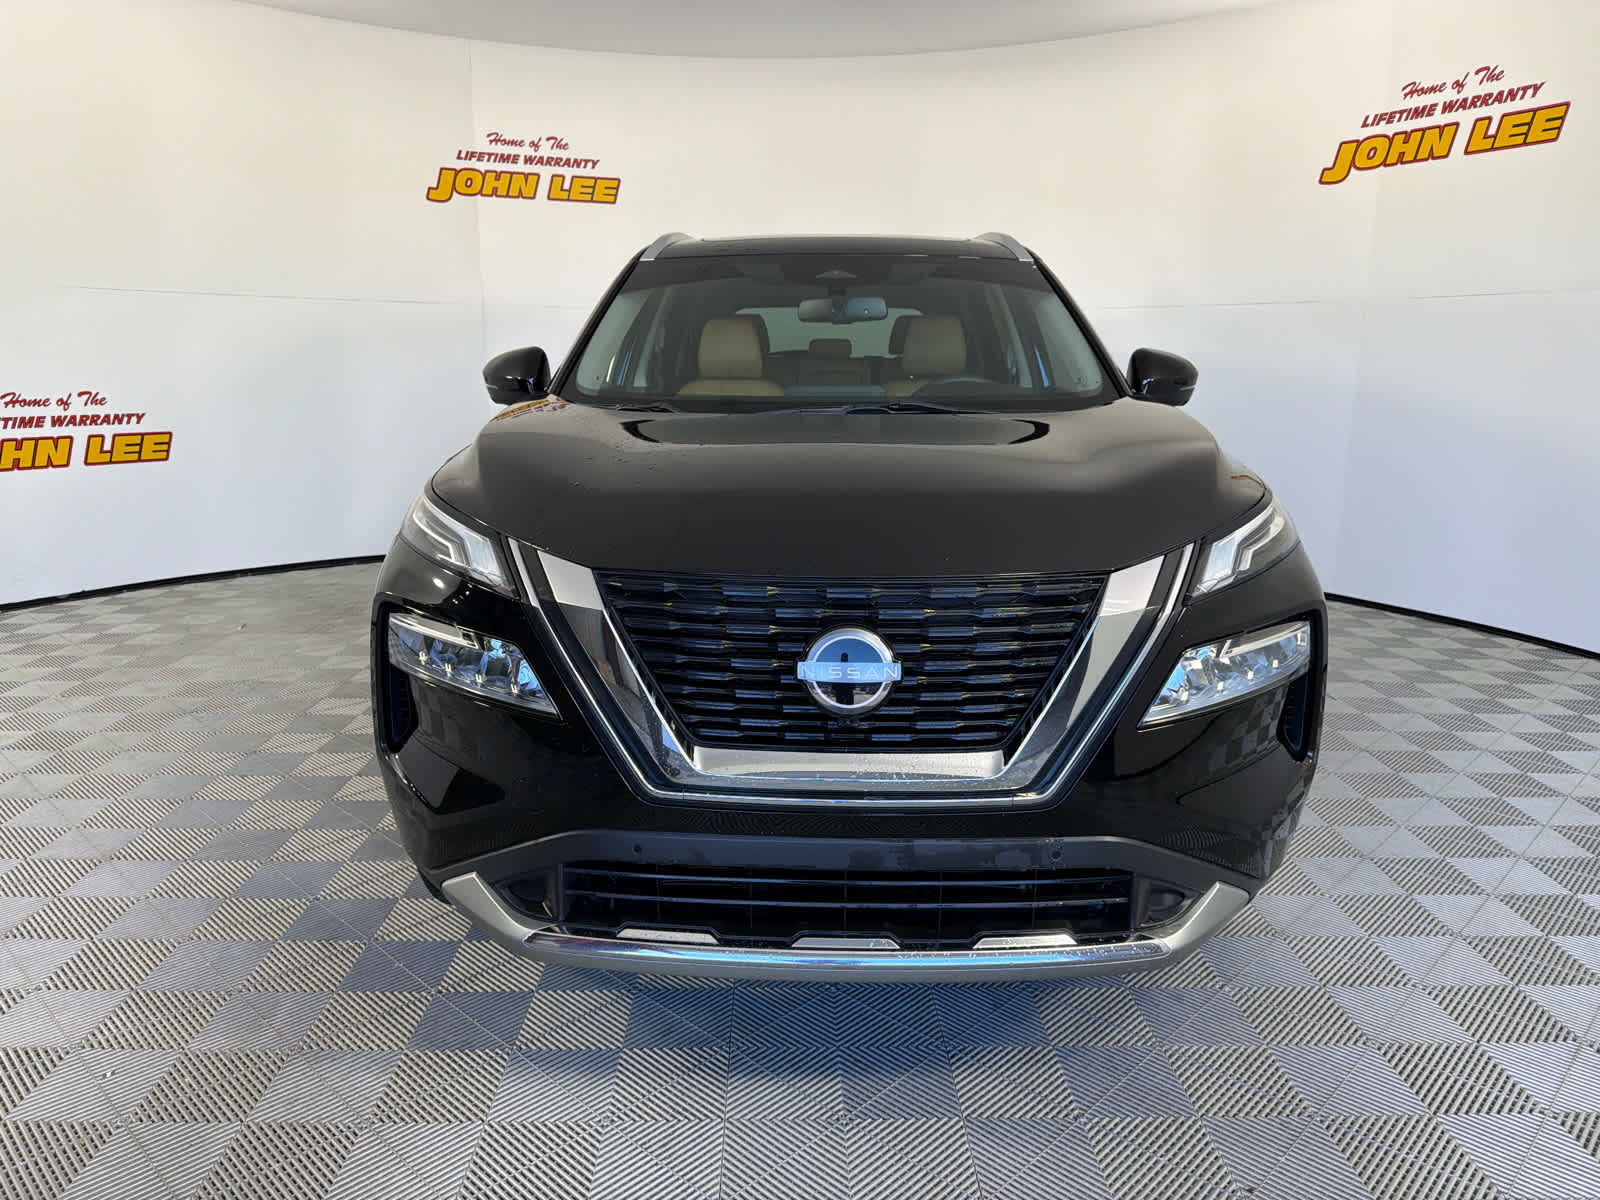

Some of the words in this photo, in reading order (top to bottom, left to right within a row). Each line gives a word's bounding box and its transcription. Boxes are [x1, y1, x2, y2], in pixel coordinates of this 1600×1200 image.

[1401, 81, 1447, 100] Home
[1451, 72, 1469, 95] of
[1474, 65, 1505, 86] The
[1360, 102, 1439, 128] LIFETIME
[1440, 81, 1546, 115] WARRANTY
[486, 132, 525, 148] Home
[529, 137, 542, 151] of
[546, 136, 570, 151] The
[1318, 121, 1460, 184] JOHN
[1464, 101, 1571, 155] LEE
[456, 150, 520, 164] LIFETIME
[523, 154, 600, 169] WARRANTY
[426, 167, 540, 203] JOHN
[547, 173, 621, 204] LEE
[0, 391, 51, 408] Home
[55, 392, 72, 411] of
[77, 390, 108, 407] The
[50, 413, 146, 428] WARRANTY
[84, 431, 172, 466] LEE
[800, 665, 898, 679] NISSAN
